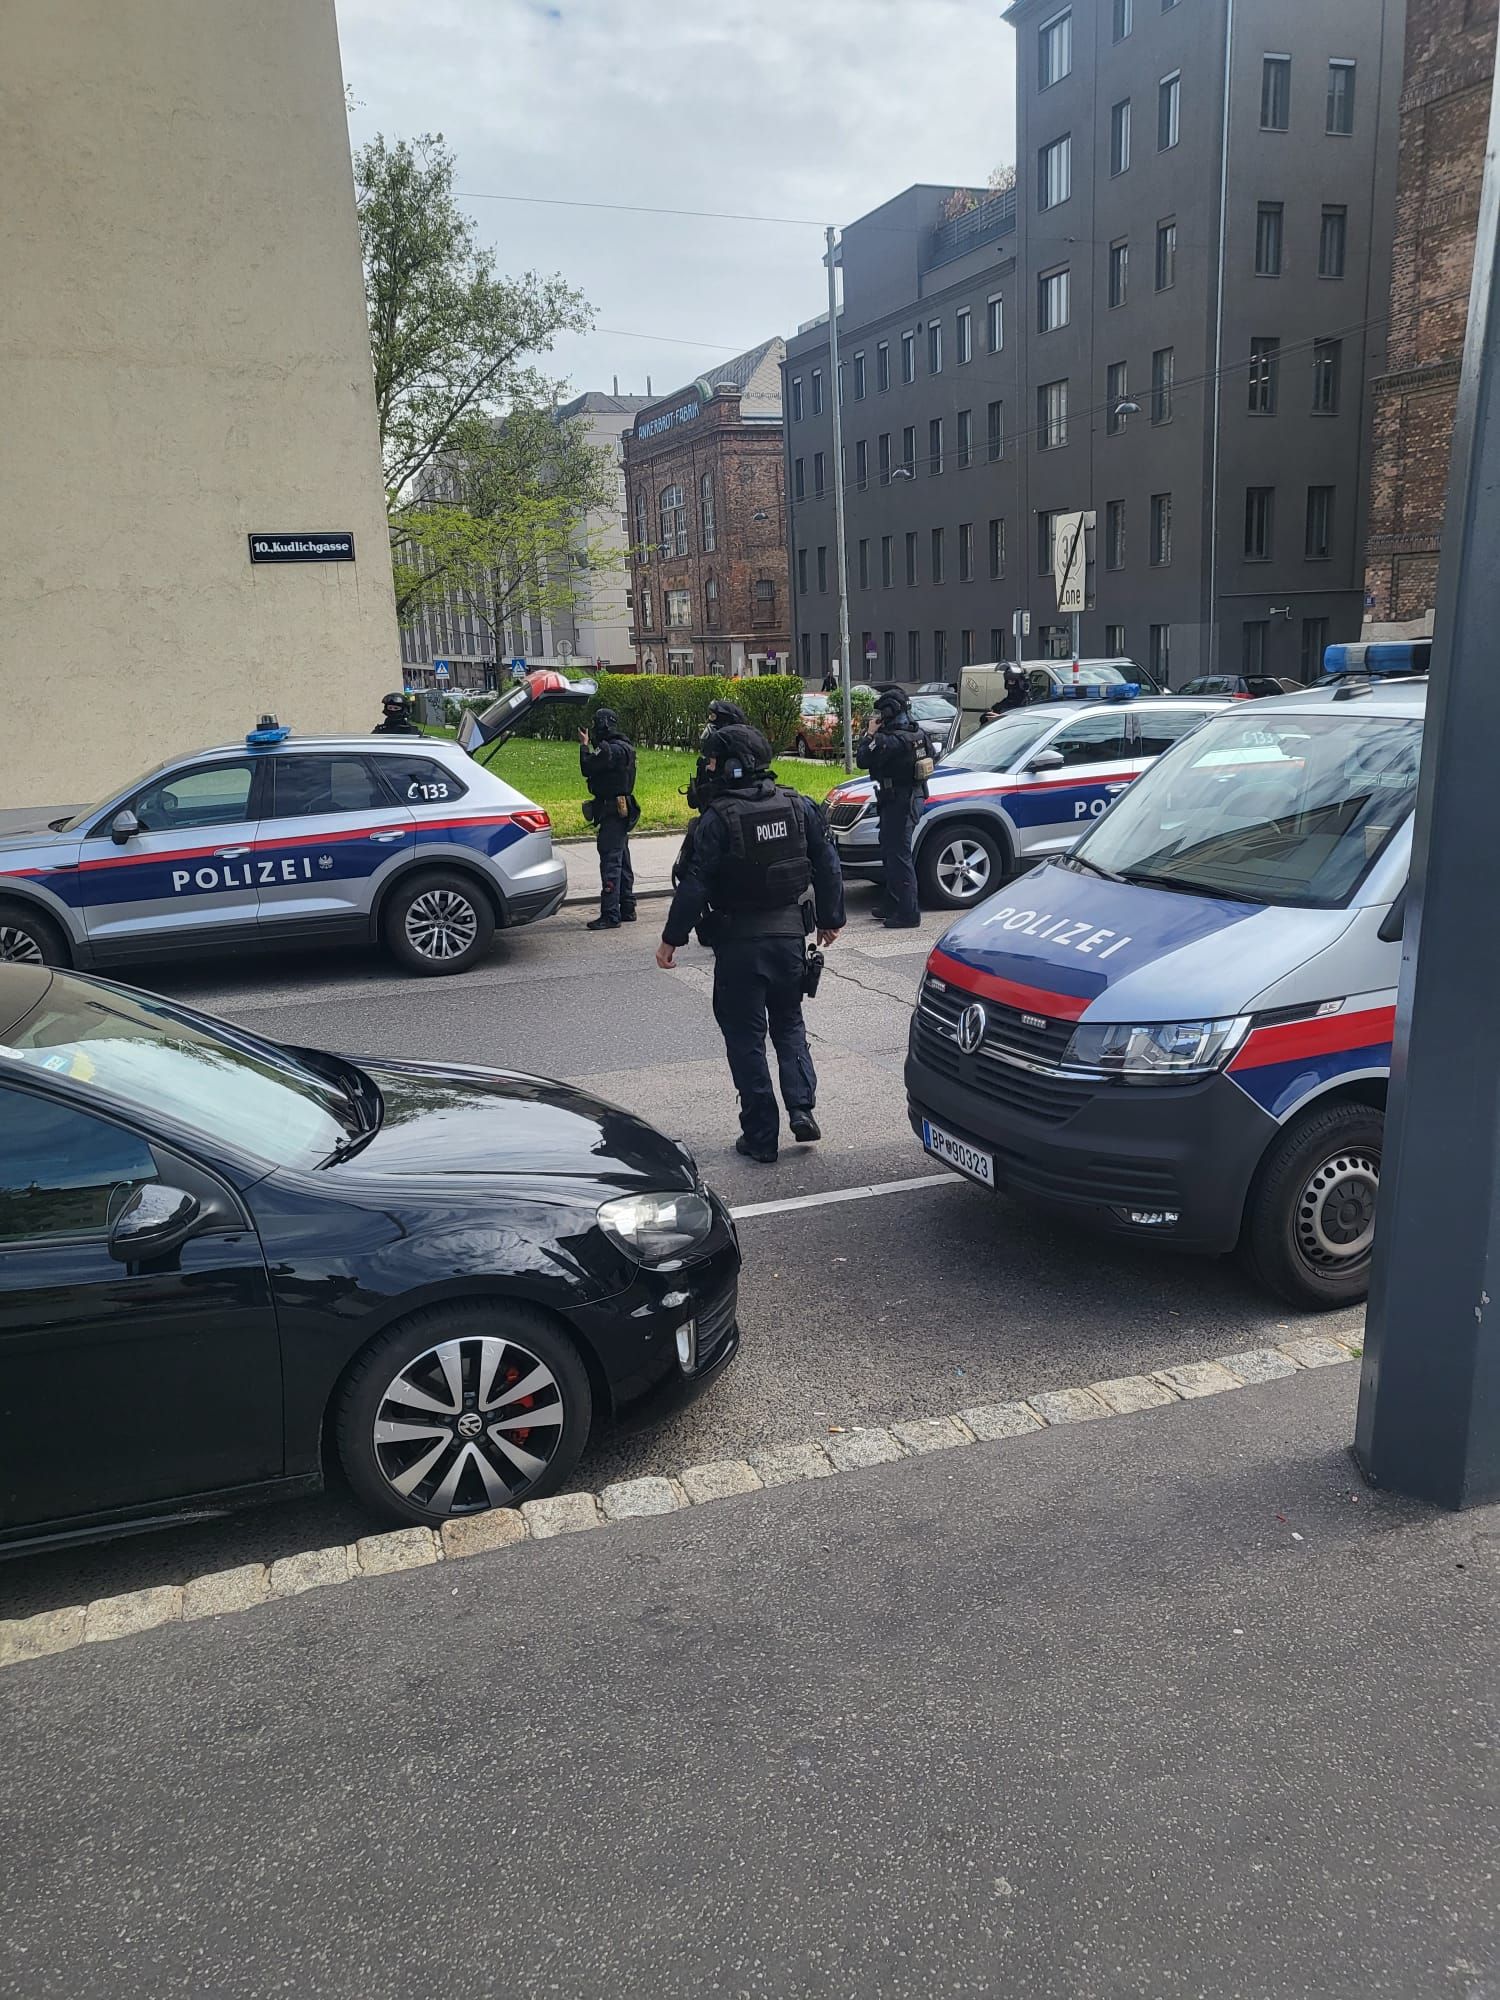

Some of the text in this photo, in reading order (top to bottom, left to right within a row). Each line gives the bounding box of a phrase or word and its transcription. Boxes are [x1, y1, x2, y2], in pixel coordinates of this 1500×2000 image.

[420, 783, 449, 800] 133
[756, 820, 788, 842] POLIZEI
[172, 857, 313, 892] POLIZEI
[981, 907, 1133, 959] POLIZEI
[931, 1128, 989, 1179] BP 90323
